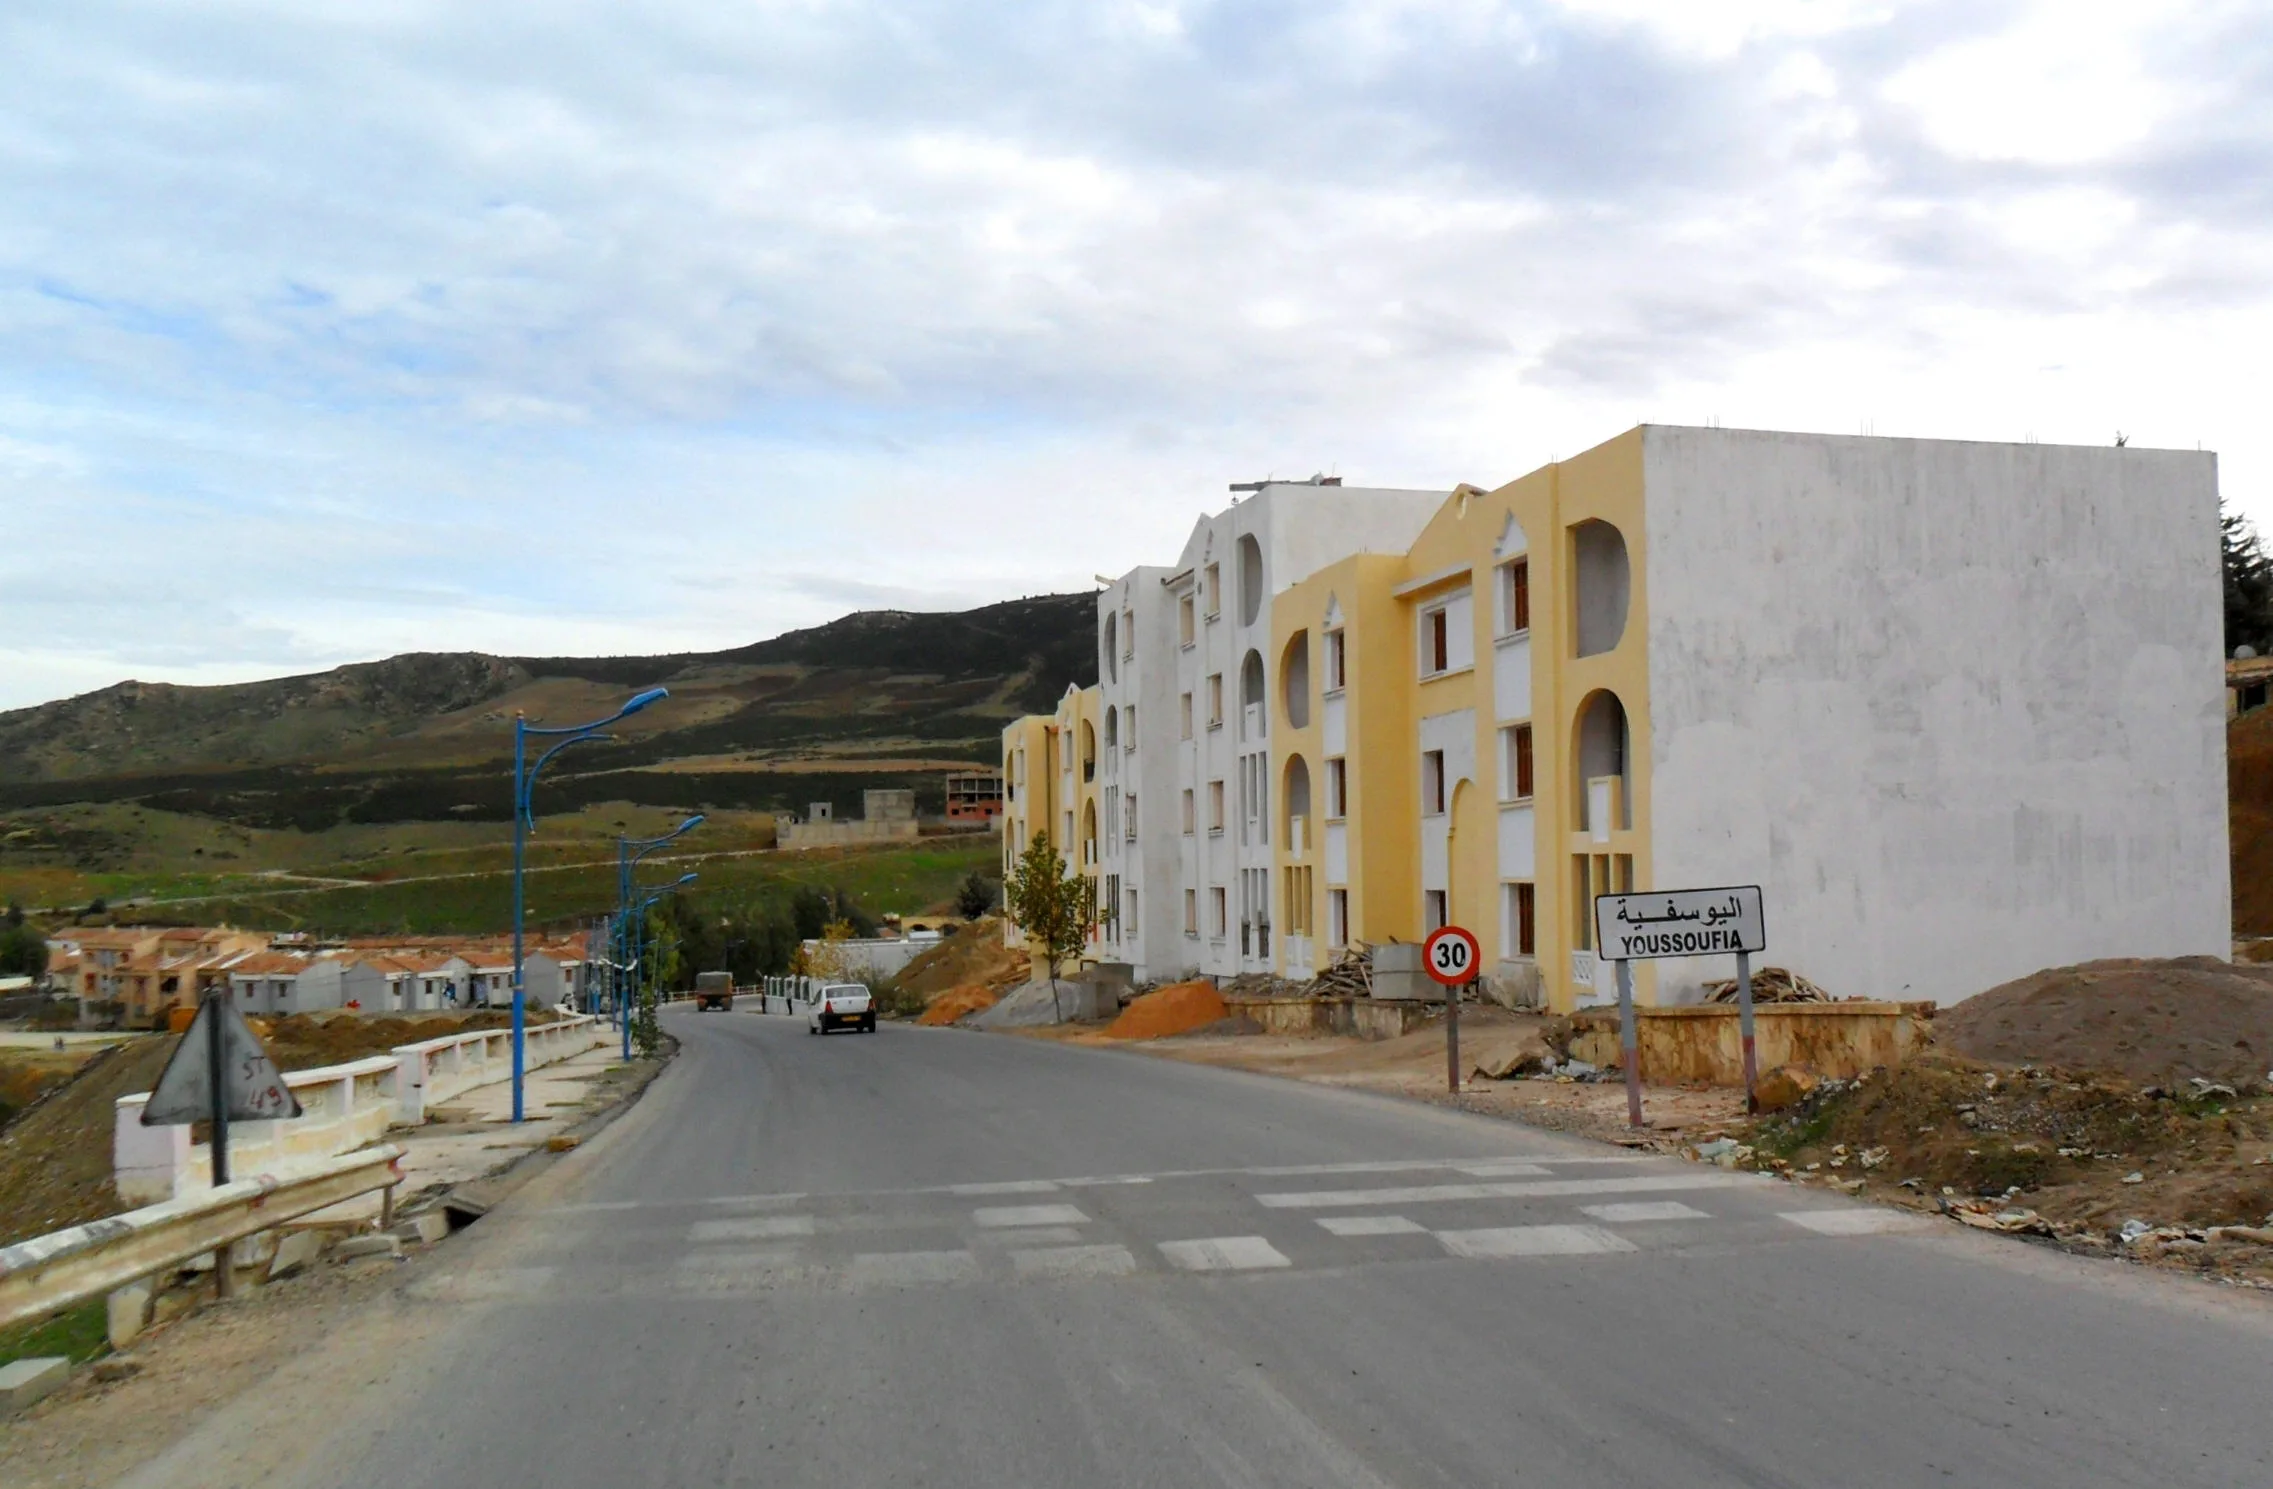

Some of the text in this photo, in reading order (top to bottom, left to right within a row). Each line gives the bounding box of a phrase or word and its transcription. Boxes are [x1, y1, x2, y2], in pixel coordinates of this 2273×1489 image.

[1616, 896, 1742, 931] اليوسفية
[1437, 942, 1466, 968] 30
[1621, 930, 1743, 955] YOUSSOUFIA
